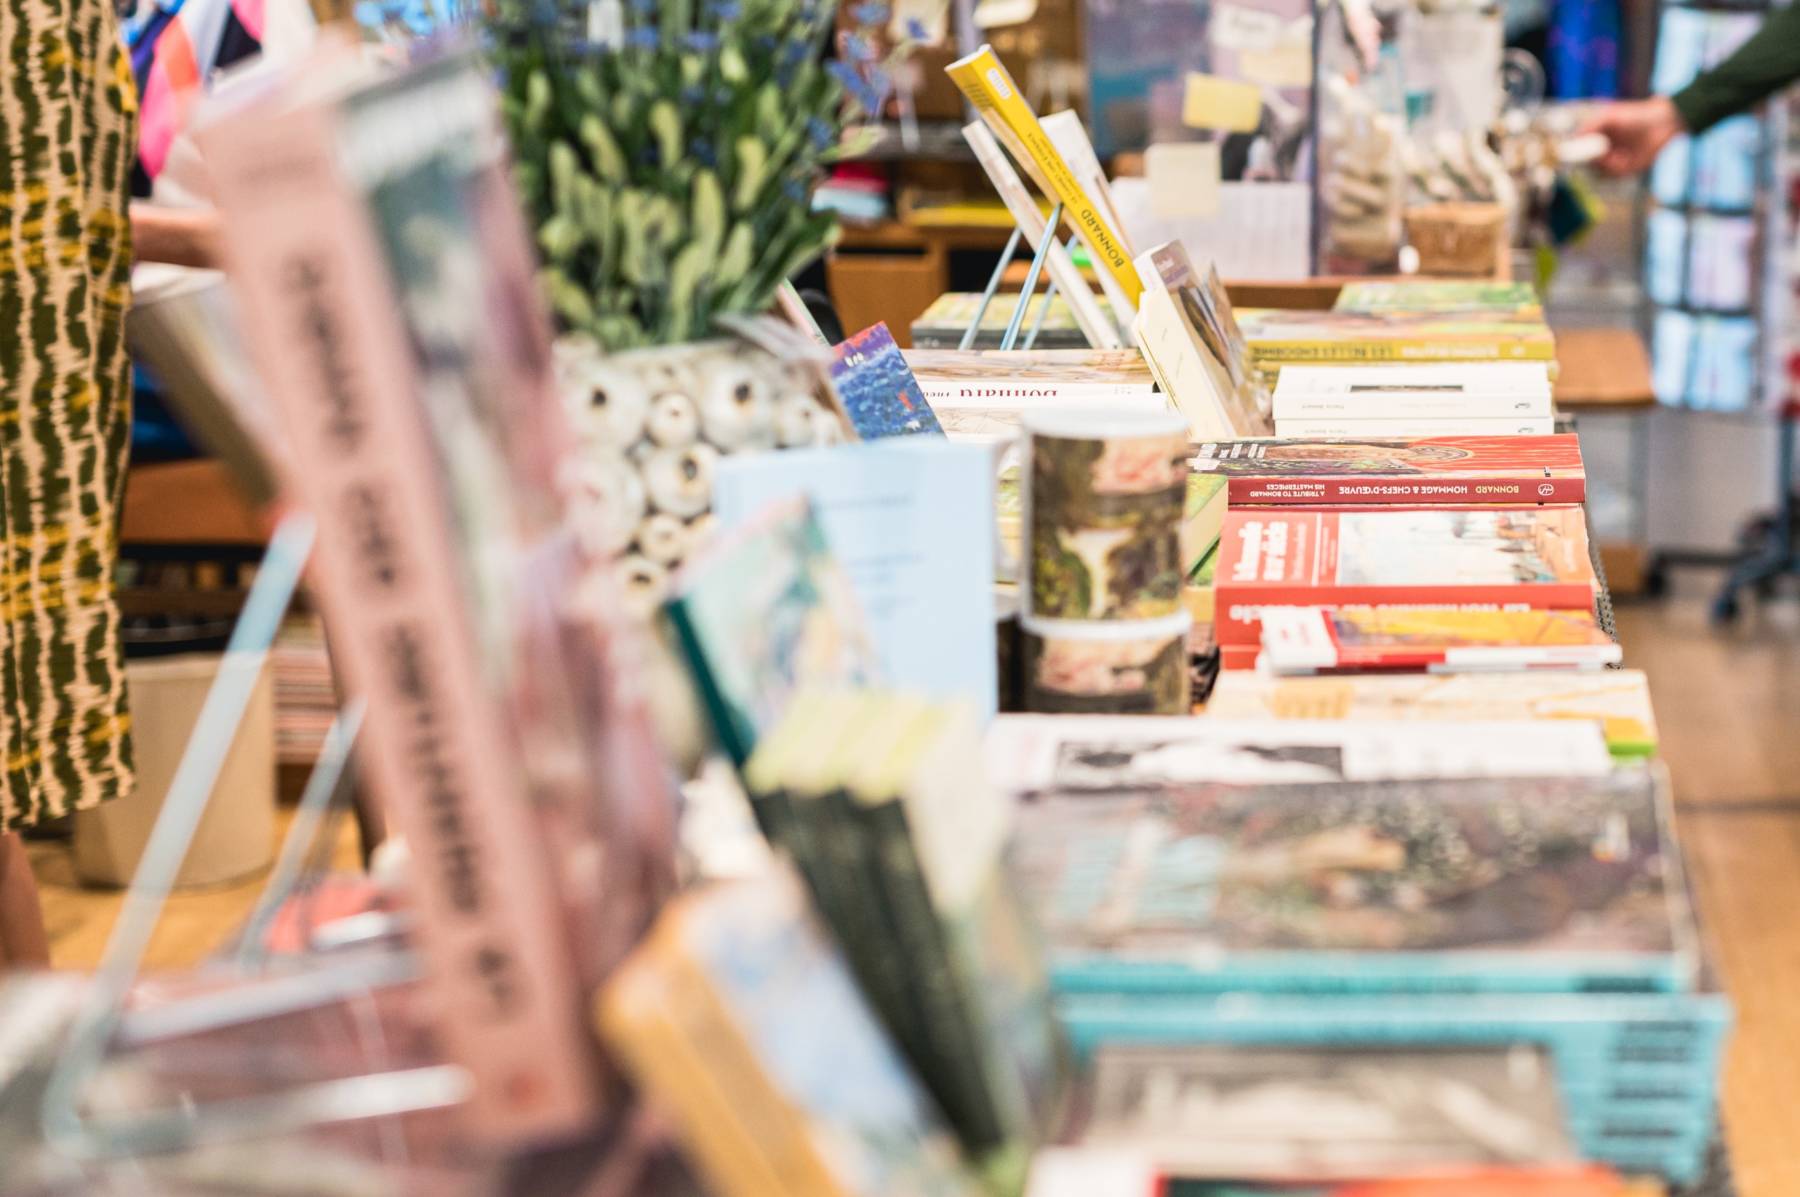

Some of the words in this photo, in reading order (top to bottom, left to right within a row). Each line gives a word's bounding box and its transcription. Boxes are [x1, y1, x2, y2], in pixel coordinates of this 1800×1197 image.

[1081, 208, 1125, 269] BONNARD
[1282, 490, 1292, 498] TO
[1293, 490, 1320, 498] TRIBUTE
[1338, 486, 1411, 495] CHEFS-D'ŒUVRE
[1412, 485, 1420, 495] &
[1420, 485, 1468, 494] HOMMAGE
[1475, 485, 1520, 494] BONNARD
